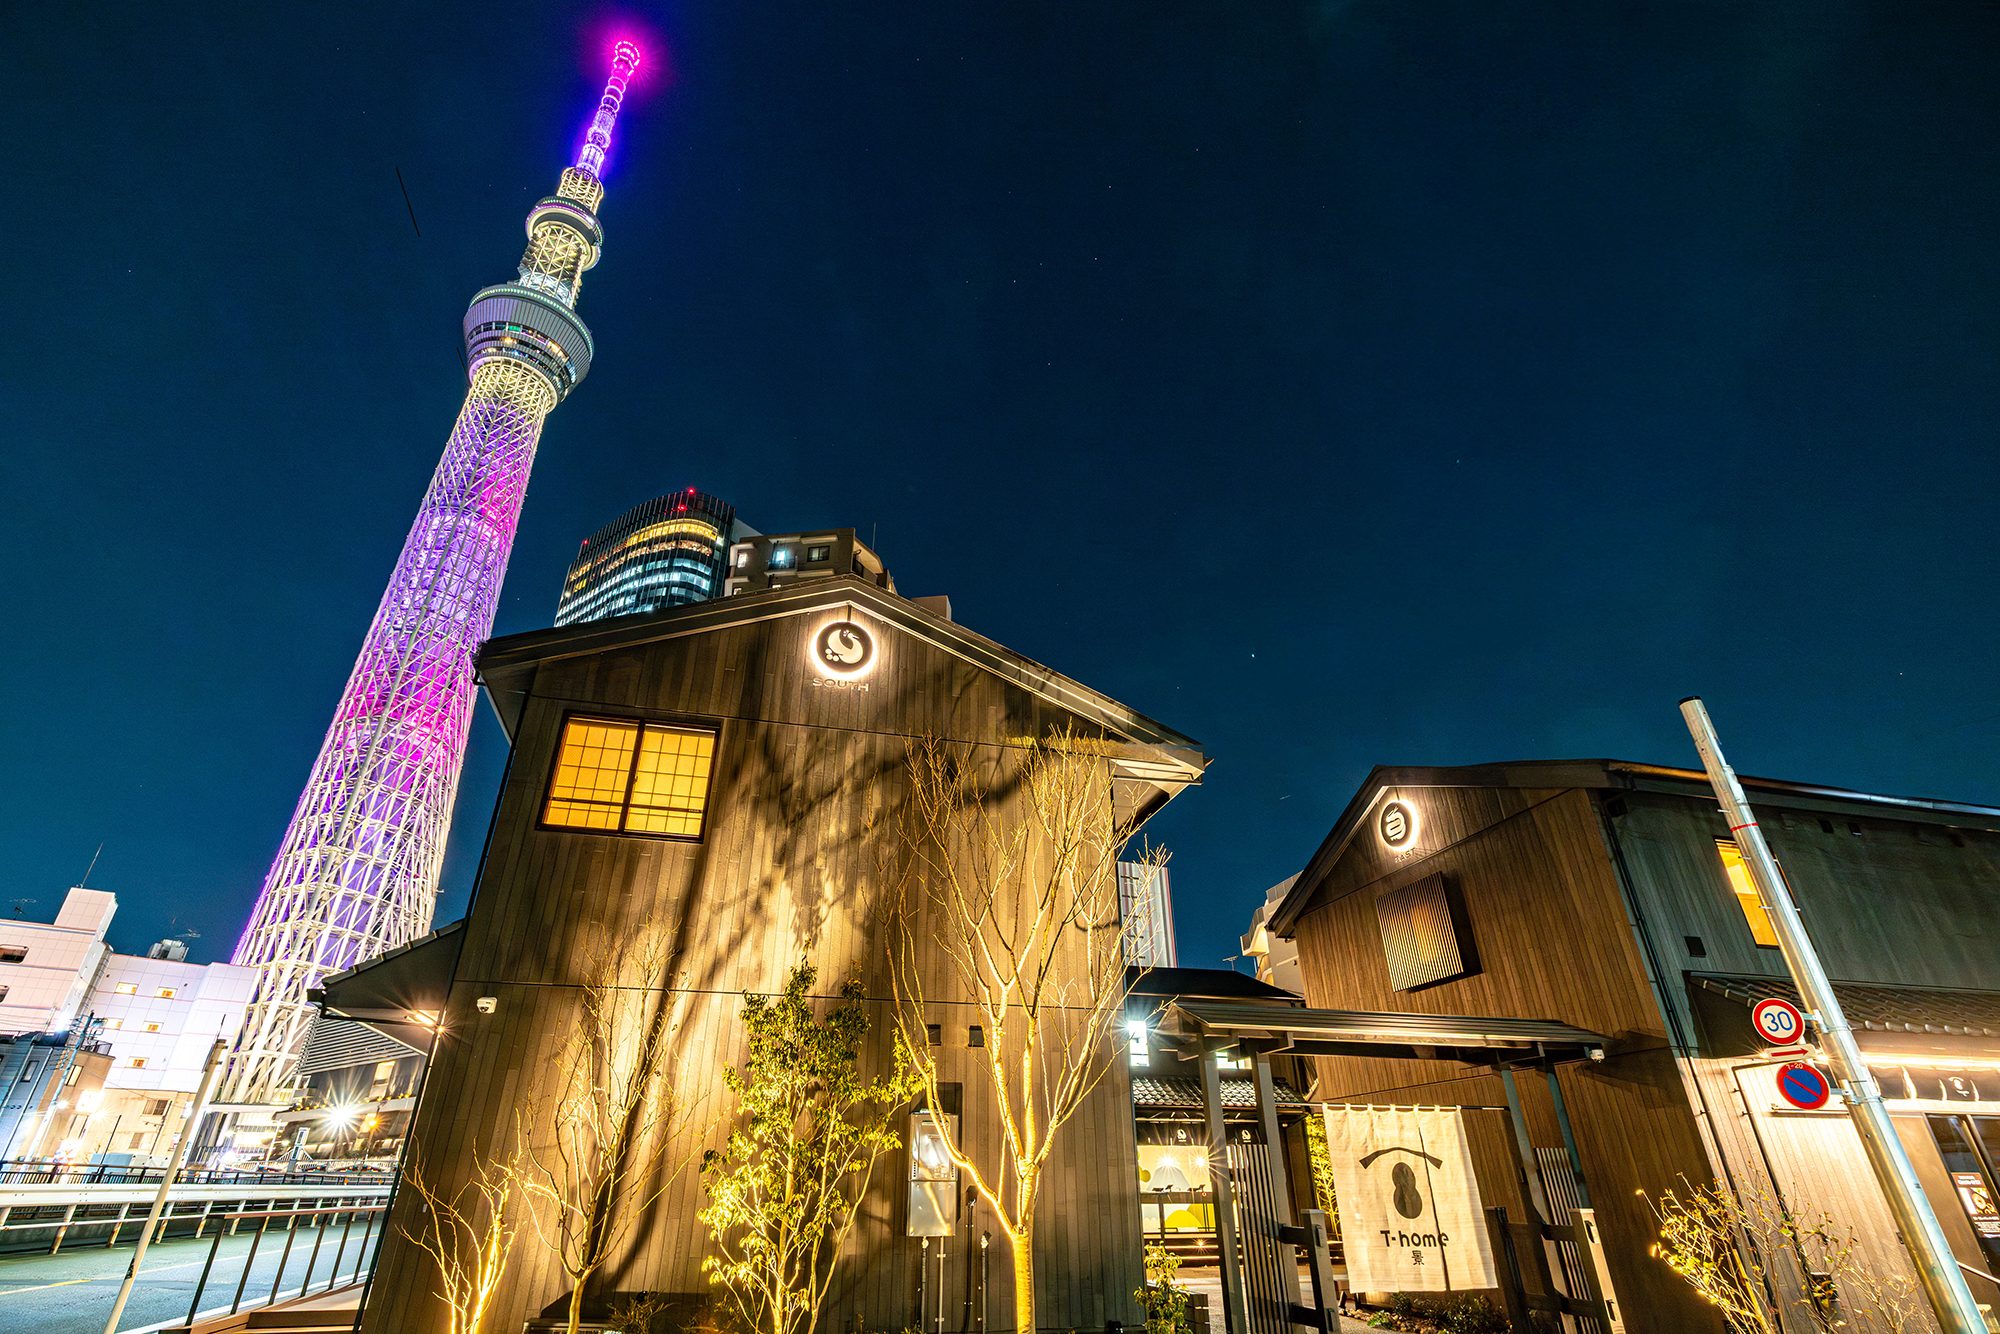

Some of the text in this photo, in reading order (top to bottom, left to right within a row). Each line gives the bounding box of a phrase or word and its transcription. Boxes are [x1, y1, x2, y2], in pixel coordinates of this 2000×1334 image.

[812, 677, 869, 691] SOUTH
[1764, 1011, 1793, 1032] 30
[1380, 1229, 1449, 1247] T-home
